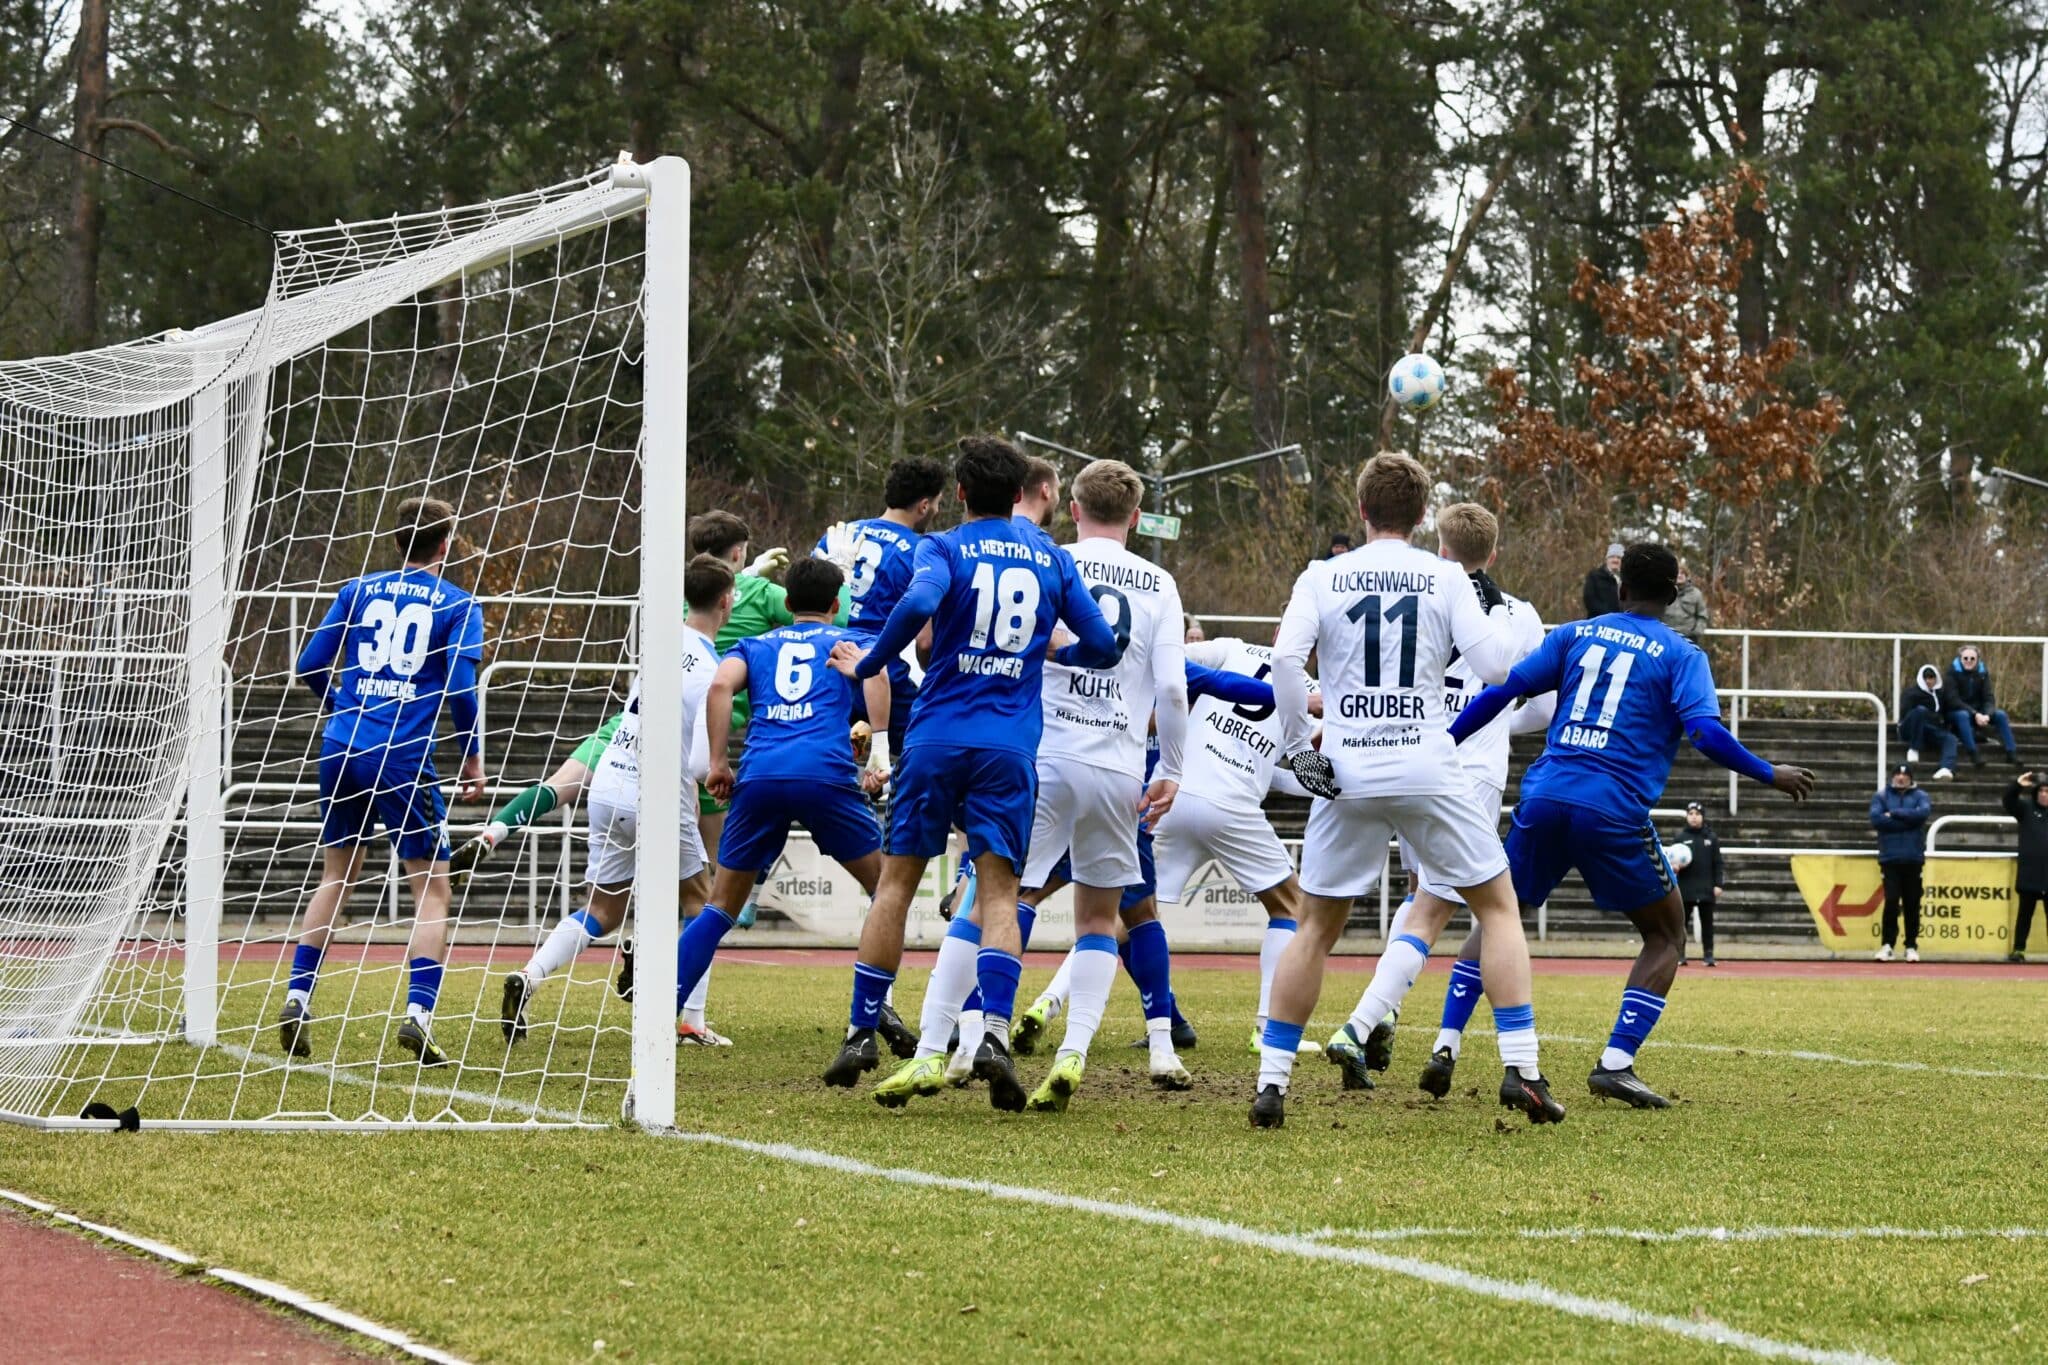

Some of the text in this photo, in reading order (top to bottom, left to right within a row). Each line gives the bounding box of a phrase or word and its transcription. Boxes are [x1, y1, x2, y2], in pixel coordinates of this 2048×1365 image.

[979, 539, 1032, 561] HERTHA
[1035, 551, 1051, 568] 03
[384, 581, 430, 599] HERTHA
[1332, 571, 1435, 595] LUCKENWALDE
[969, 562, 1040, 653] 18
[357, 598, 434, 676] 30
[1346, 595, 1418, 688] 11
[1595, 625, 1647, 651] HERTHA
[1646, 640, 1665, 658] 03
[775, 642, 816, 702] 6
[958, 653, 1024, 680] WAGNER
[1068, 669, 1122, 701] KÜHN
[1570, 643, 1636, 729] 11
[766, 702, 814, 721] VIEIRA
[1340, 694, 1425, 720] GRUBER
[1055, 710, 1128, 732] Märkischer Hof
[1206, 711, 1276, 758] ALBRECHT
[1342, 735, 1421, 748] Märkischer Hof
[1205, 743, 1244, 770] Märkischer
[775, 876, 833, 896] artesia
[1040, 908, 1075, 923] Berli
[1939, 925, 1960, 940] 88
